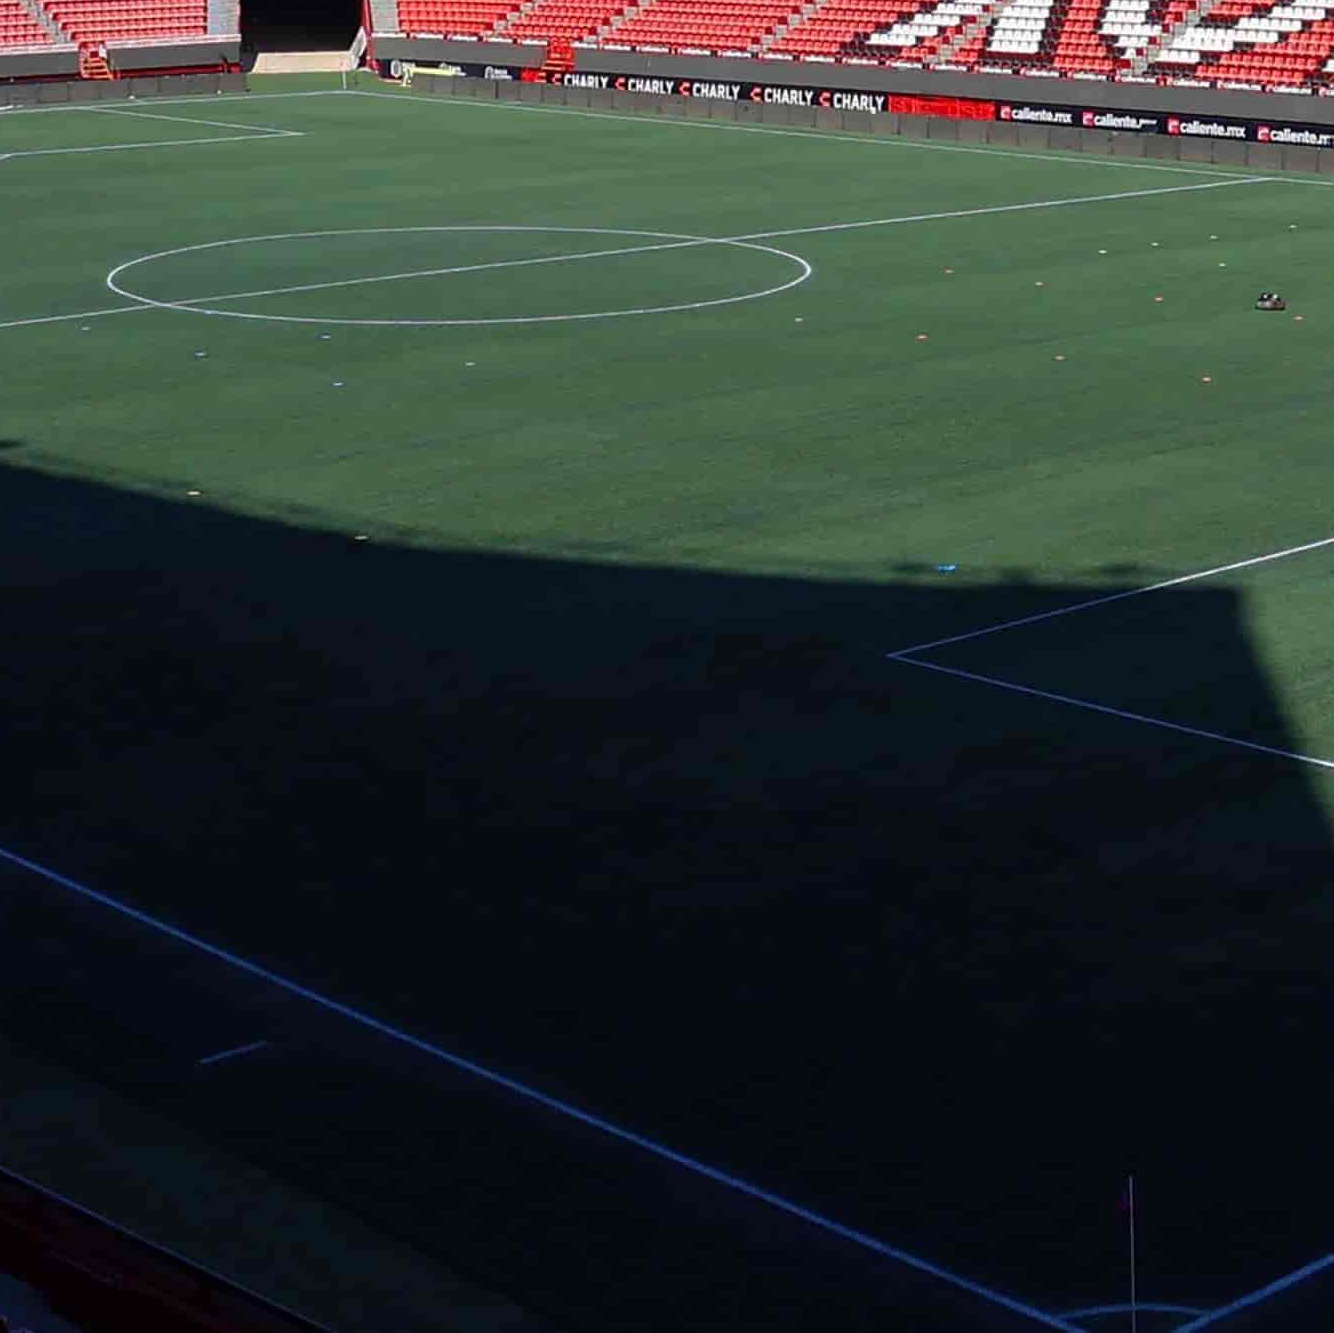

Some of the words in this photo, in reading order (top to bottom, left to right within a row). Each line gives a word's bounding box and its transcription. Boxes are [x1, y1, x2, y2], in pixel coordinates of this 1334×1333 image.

[627, 77, 675, 95] CHARLY
[692, 82, 741, 101] CHARLY
[764, 87, 815, 106] CHARLY
[833, 93, 886, 112] CHARLY
[1010, 107, 1072, 125] caliente.mx
[1180, 121, 1246, 139] caliente.mx
